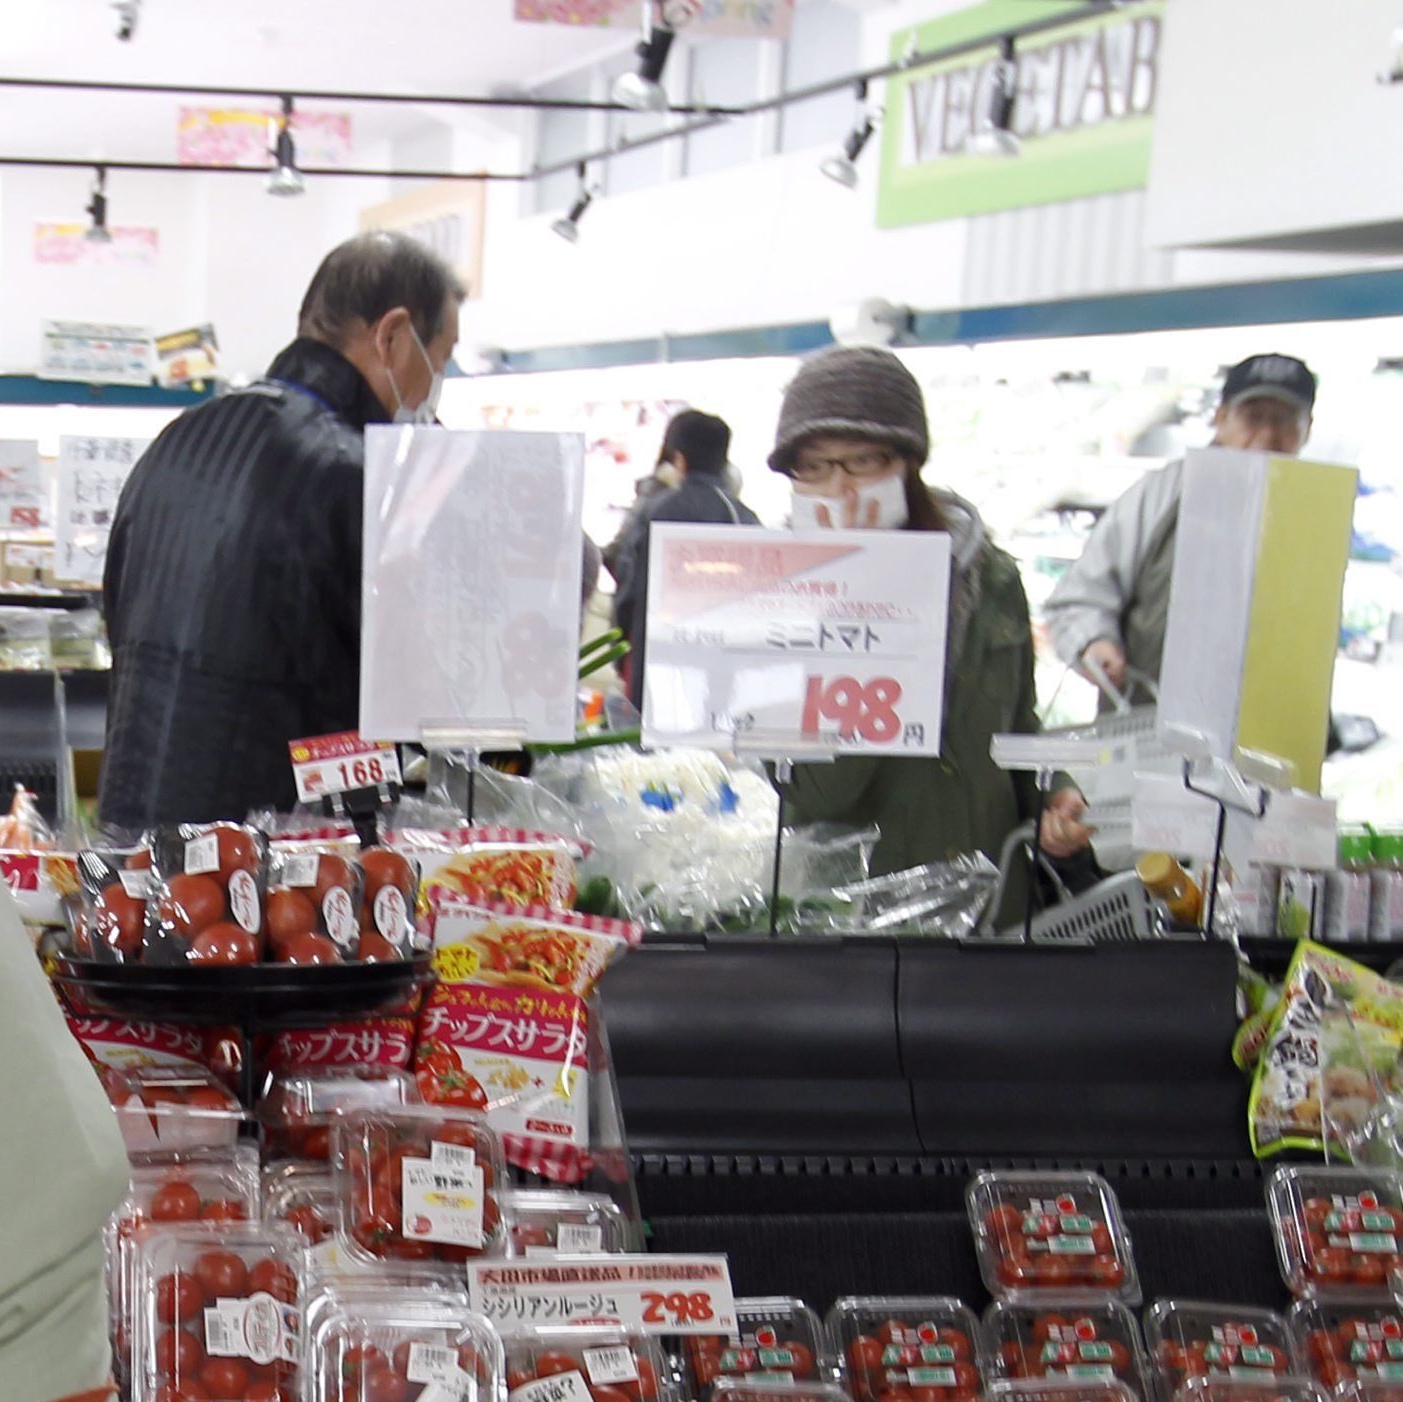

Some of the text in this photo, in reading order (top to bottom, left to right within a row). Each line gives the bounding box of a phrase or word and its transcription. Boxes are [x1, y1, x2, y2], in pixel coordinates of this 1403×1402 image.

[766, 621, 881, 651] ミニトマト
[801, 673, 902, 745] 198
[338, 757, 384, 790] 168
[482, 1292, 618, 1318] シシリアンルージュ
[640, 1290, 715, 1324] 298
